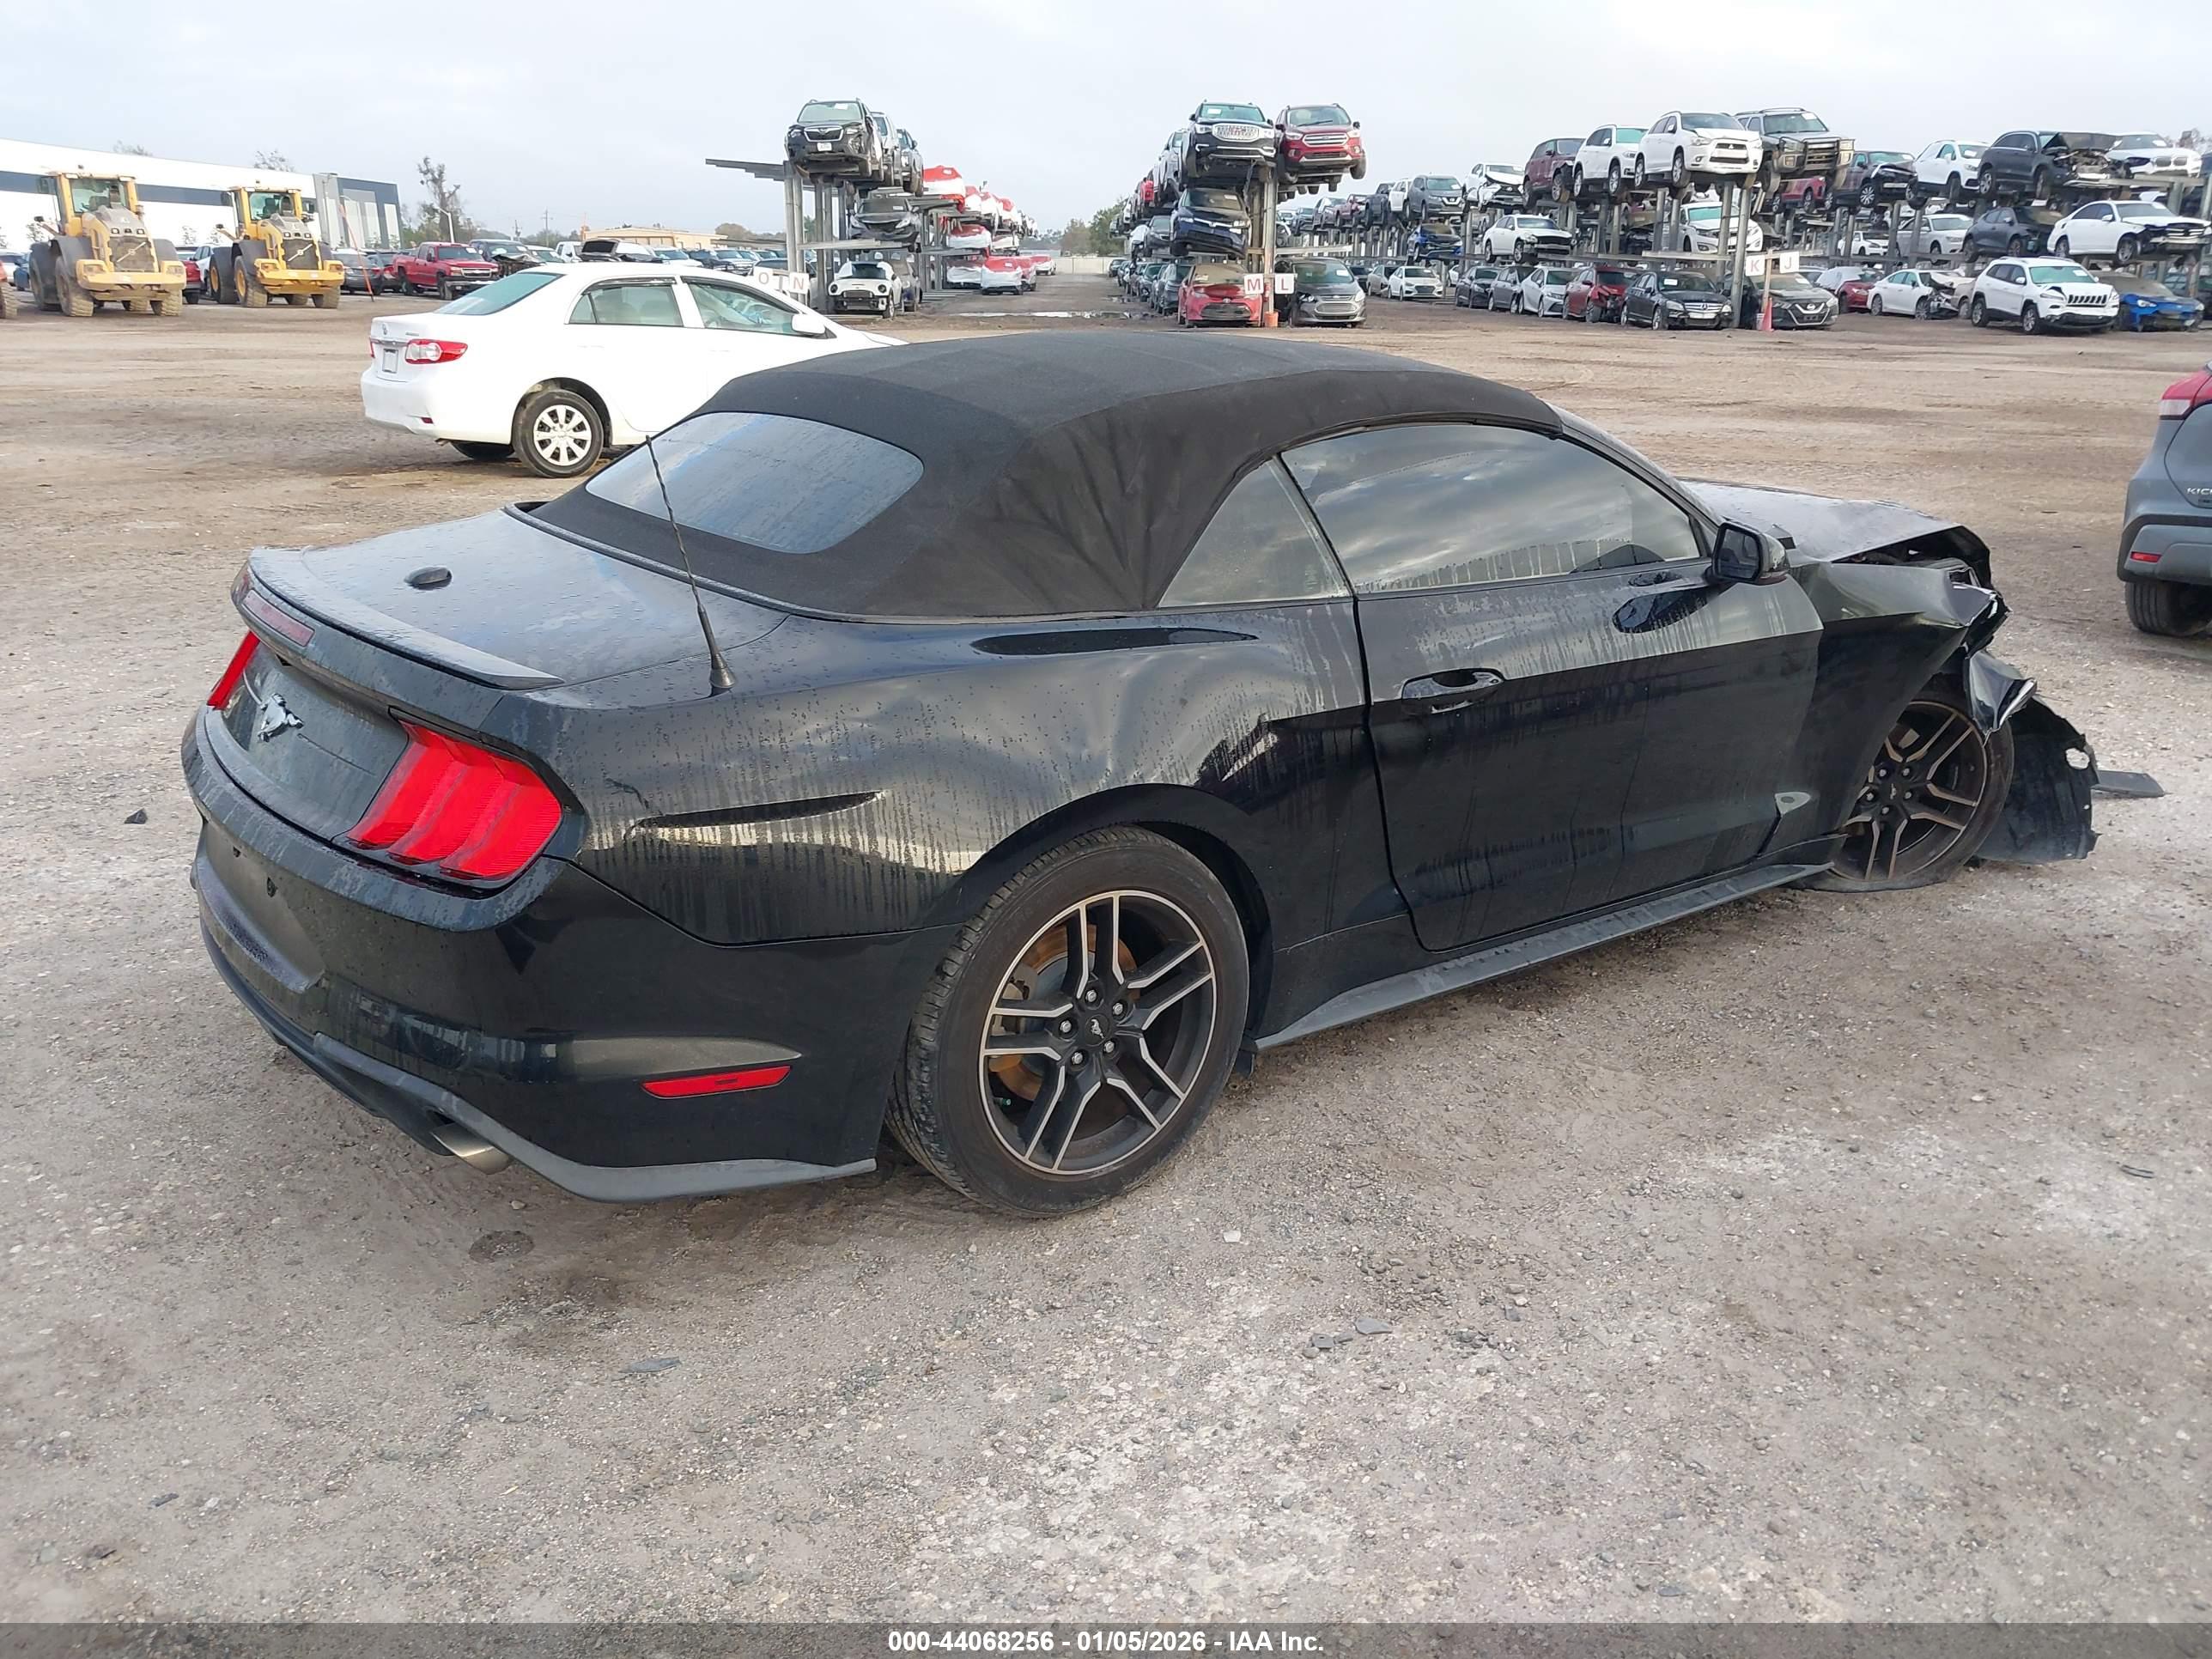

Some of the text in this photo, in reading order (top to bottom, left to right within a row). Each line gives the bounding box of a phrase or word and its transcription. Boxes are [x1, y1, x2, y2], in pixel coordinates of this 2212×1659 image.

[1750, 259, 1760, 272] K
[1784, 257, 1792, 270] J
[758, 271, 769, 285] O
[793, 276, 804, 290] N
[1247, 278, 1261, 291] M
[1281, 277, 1289, 290] L
